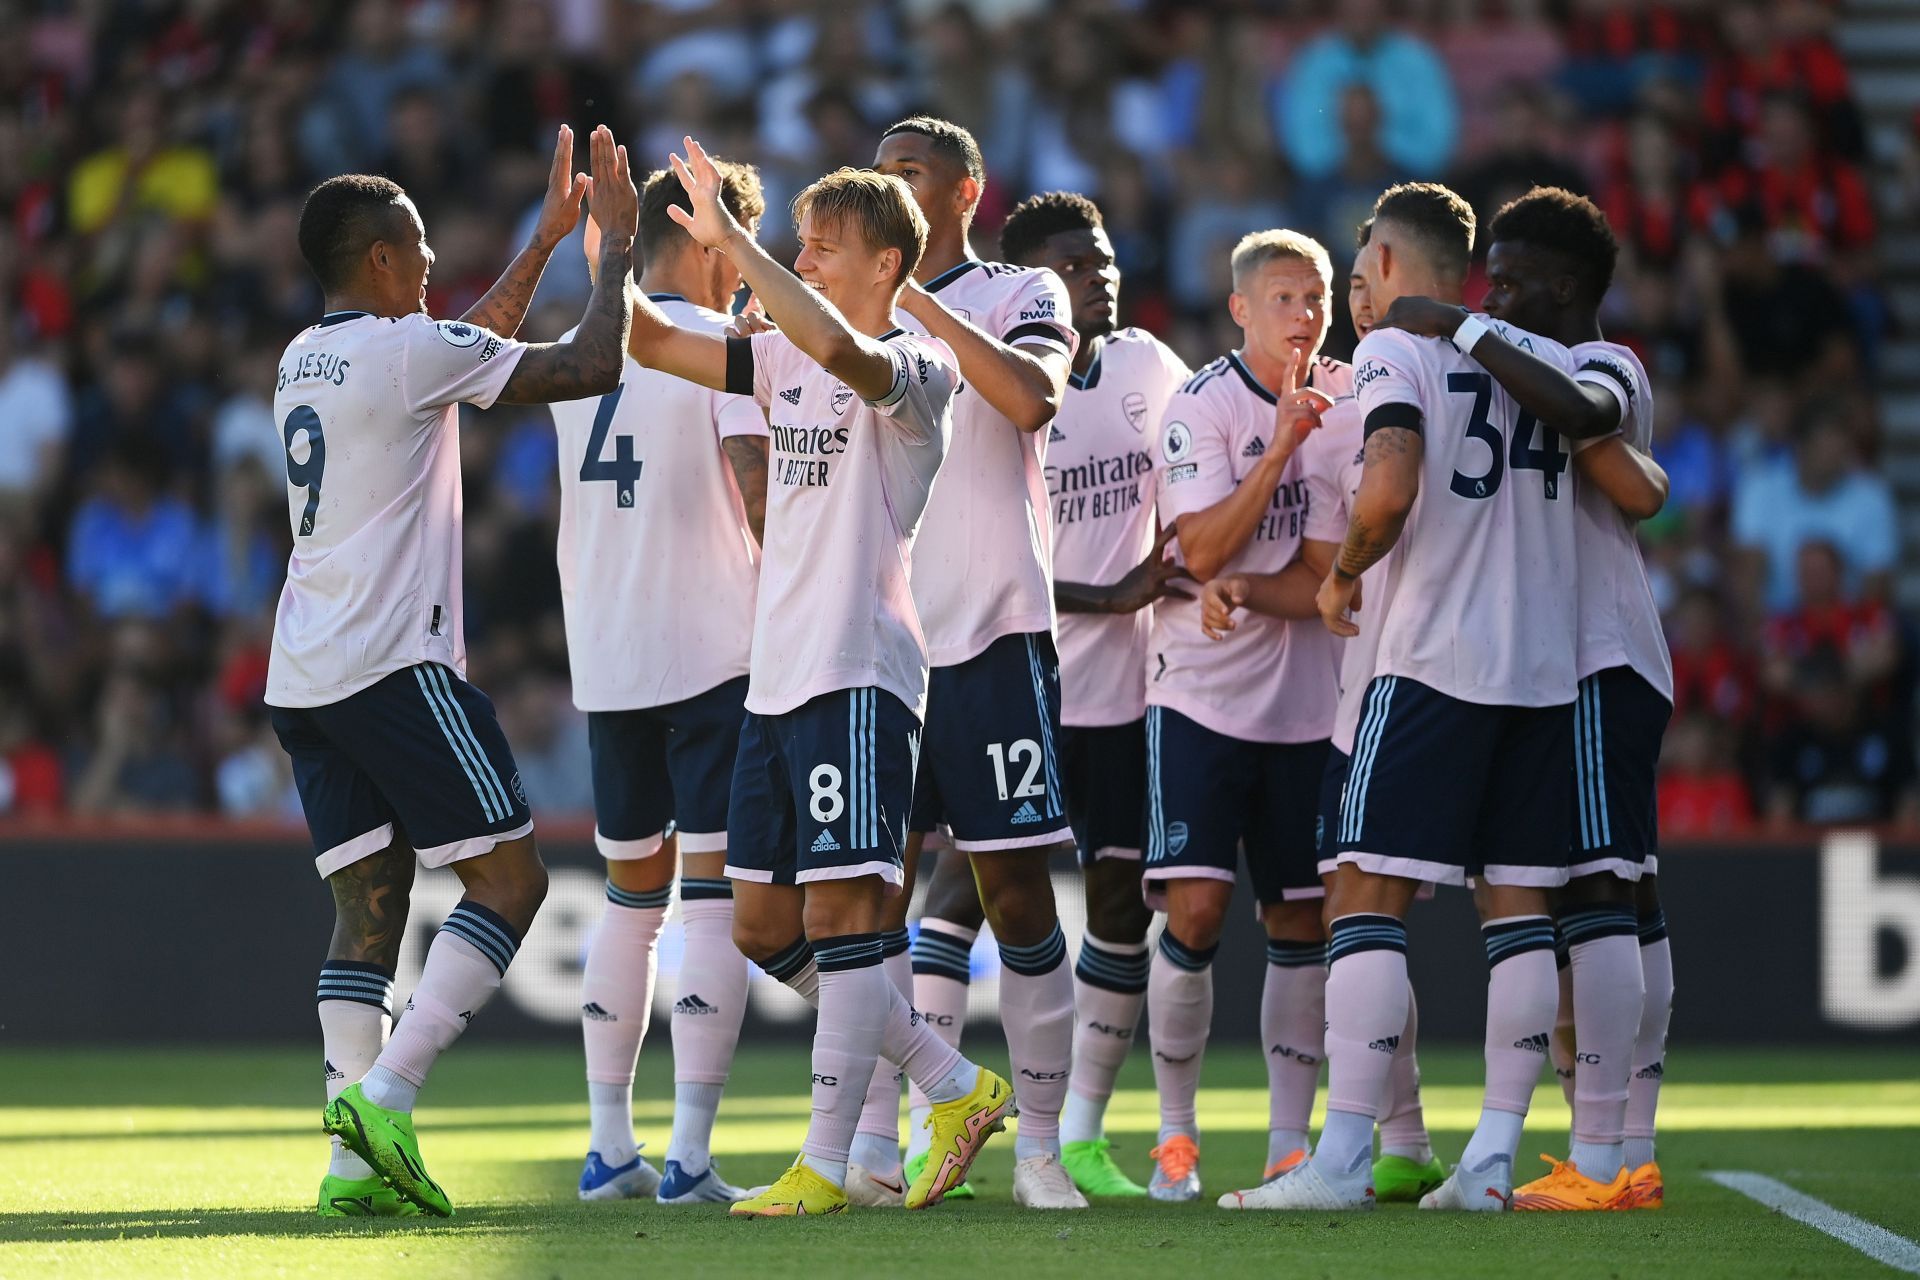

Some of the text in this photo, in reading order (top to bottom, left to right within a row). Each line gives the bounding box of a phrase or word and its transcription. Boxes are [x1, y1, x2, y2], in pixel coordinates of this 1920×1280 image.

[579, 382, 643, 509] 4
[770, 424, 850, 455] mirates
[1447, 372, 1569, 500] 34
[283, 404, 327, 537] 9
[1058, 495, 1087, 524] FLY
[808, 763, 845, 823] 8
[986, 738, 1046, 800] 12
[812, 1073, 838, 1087] FC
[1575, 1052, 1601, 1064] FC
